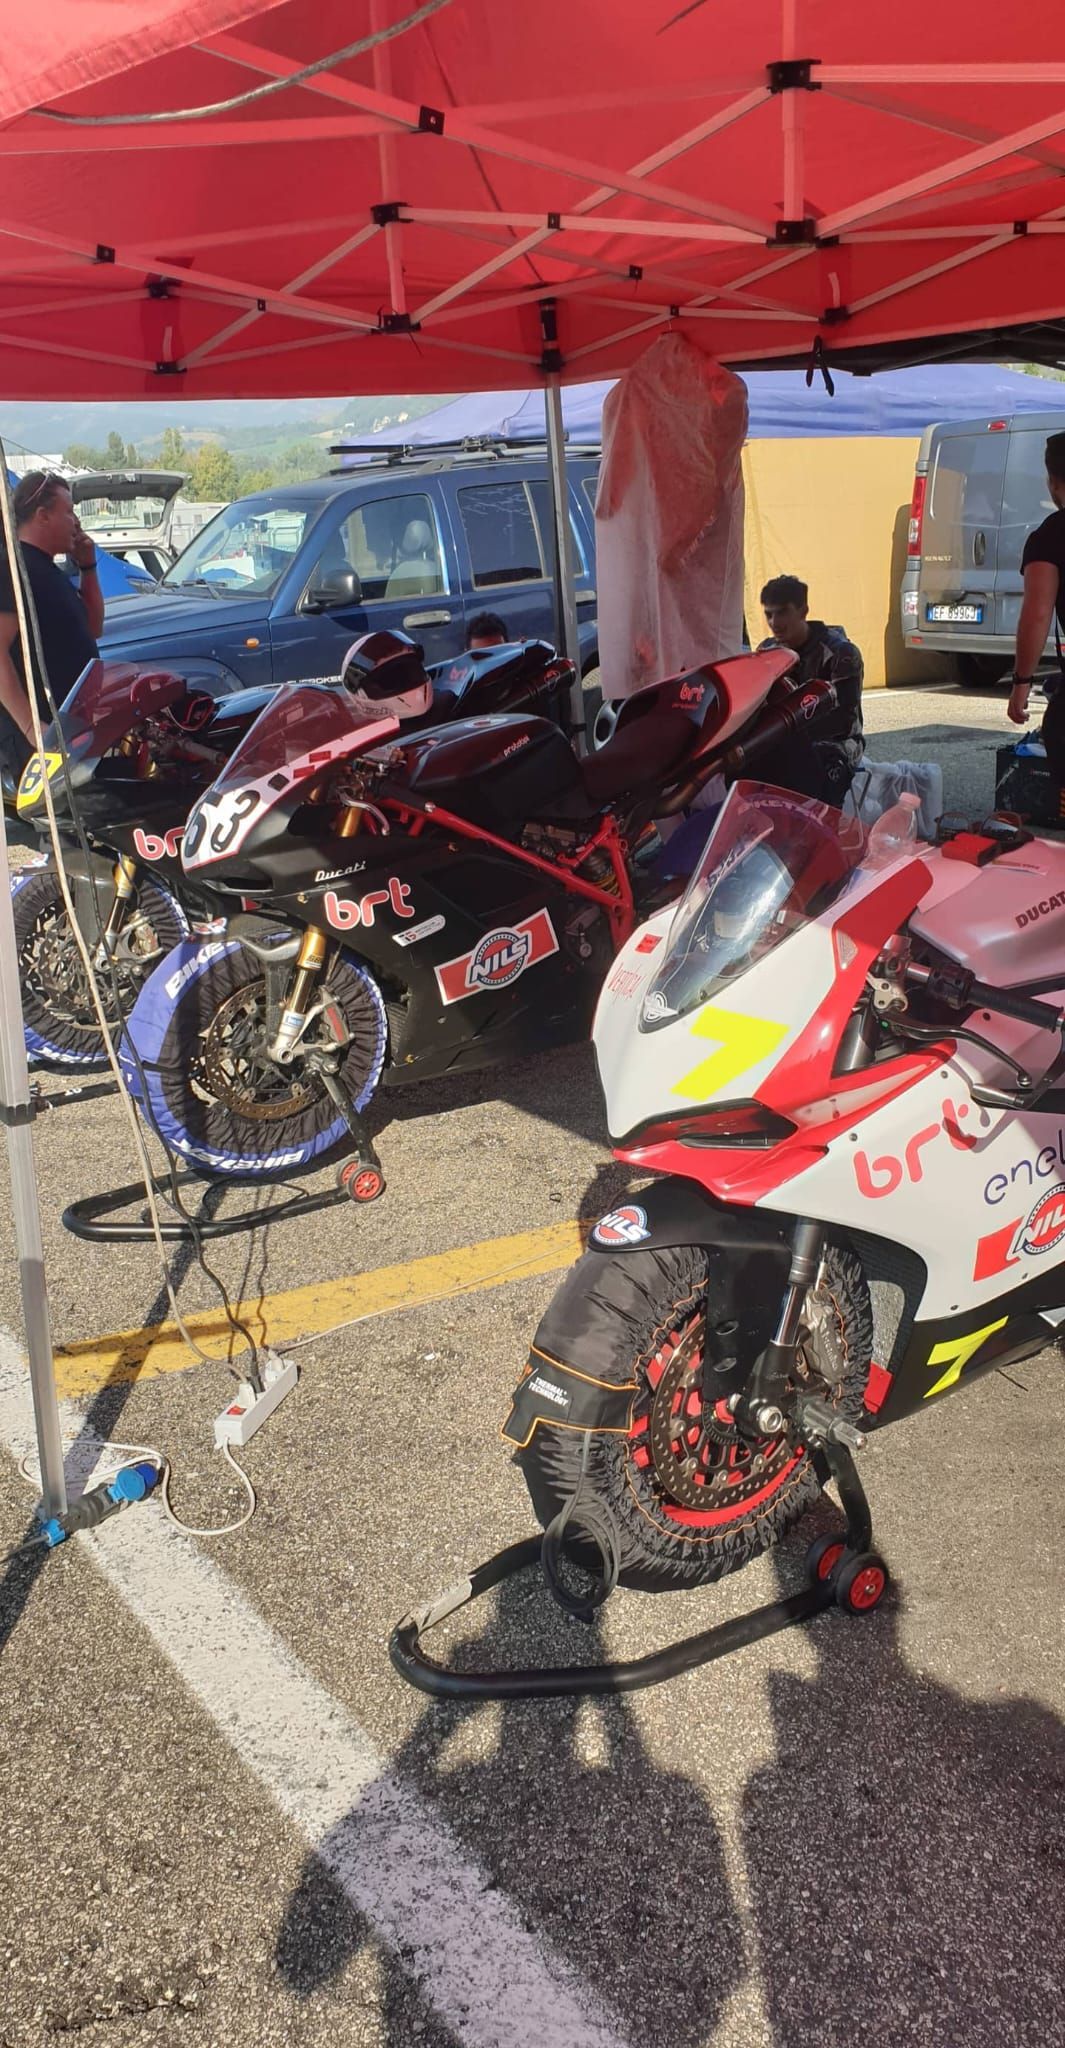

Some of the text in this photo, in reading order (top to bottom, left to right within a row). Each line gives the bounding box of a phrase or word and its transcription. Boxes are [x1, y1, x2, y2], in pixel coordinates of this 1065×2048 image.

[680, 681, 705, 702] brt
[133, 826, 188, 861] br
[315, 861, 366, 882] Ducati
[324, 877, 415, 930] brt
[1016, 891, 1065, 928] DUCAT
[470, 936, 529, 984] NILS
[670, 1004, 791, 1102] 7
[853, 1098, 977, 1199] brt
[594, 1213, 650, 1244] NILS
[1013, 1203, 1065, 1253] NIL
[922, 1315, 1009, 1399] 7
